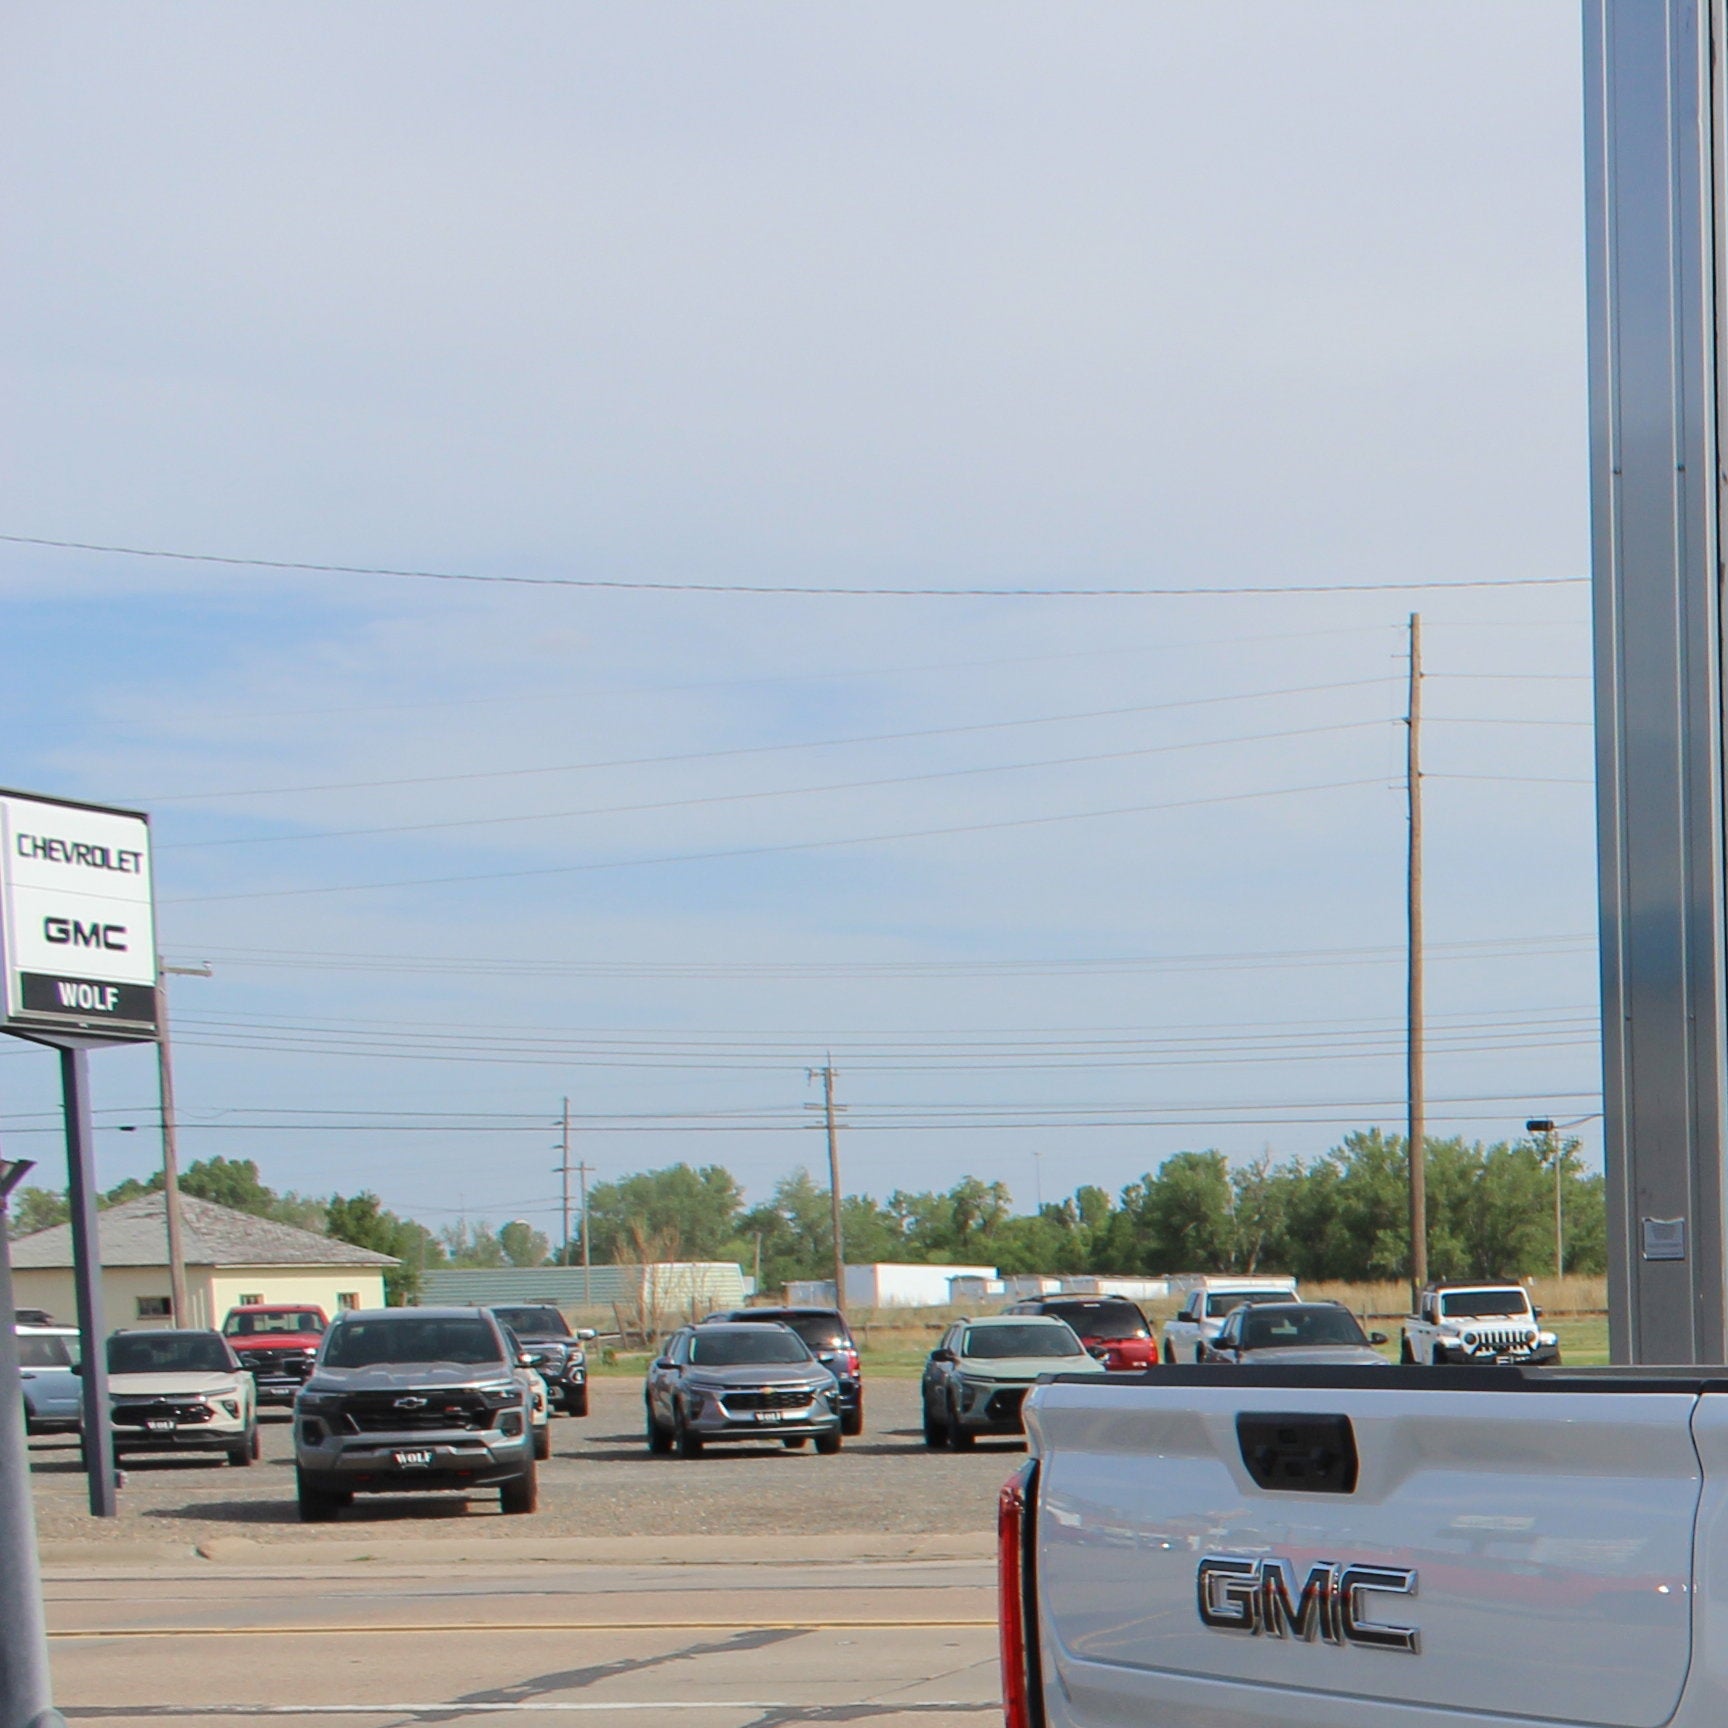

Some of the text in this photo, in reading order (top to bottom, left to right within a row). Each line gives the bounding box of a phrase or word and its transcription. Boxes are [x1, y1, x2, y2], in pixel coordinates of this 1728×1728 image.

[17, 832, 143, 874] CHEVROLET
[44, 916, 128, 951] GMC
[57, 981, 119, 1012] WOLF
[395, 1450, 433, 1464] WOLF
[1197, 1554, 1423, 1655] GMC
